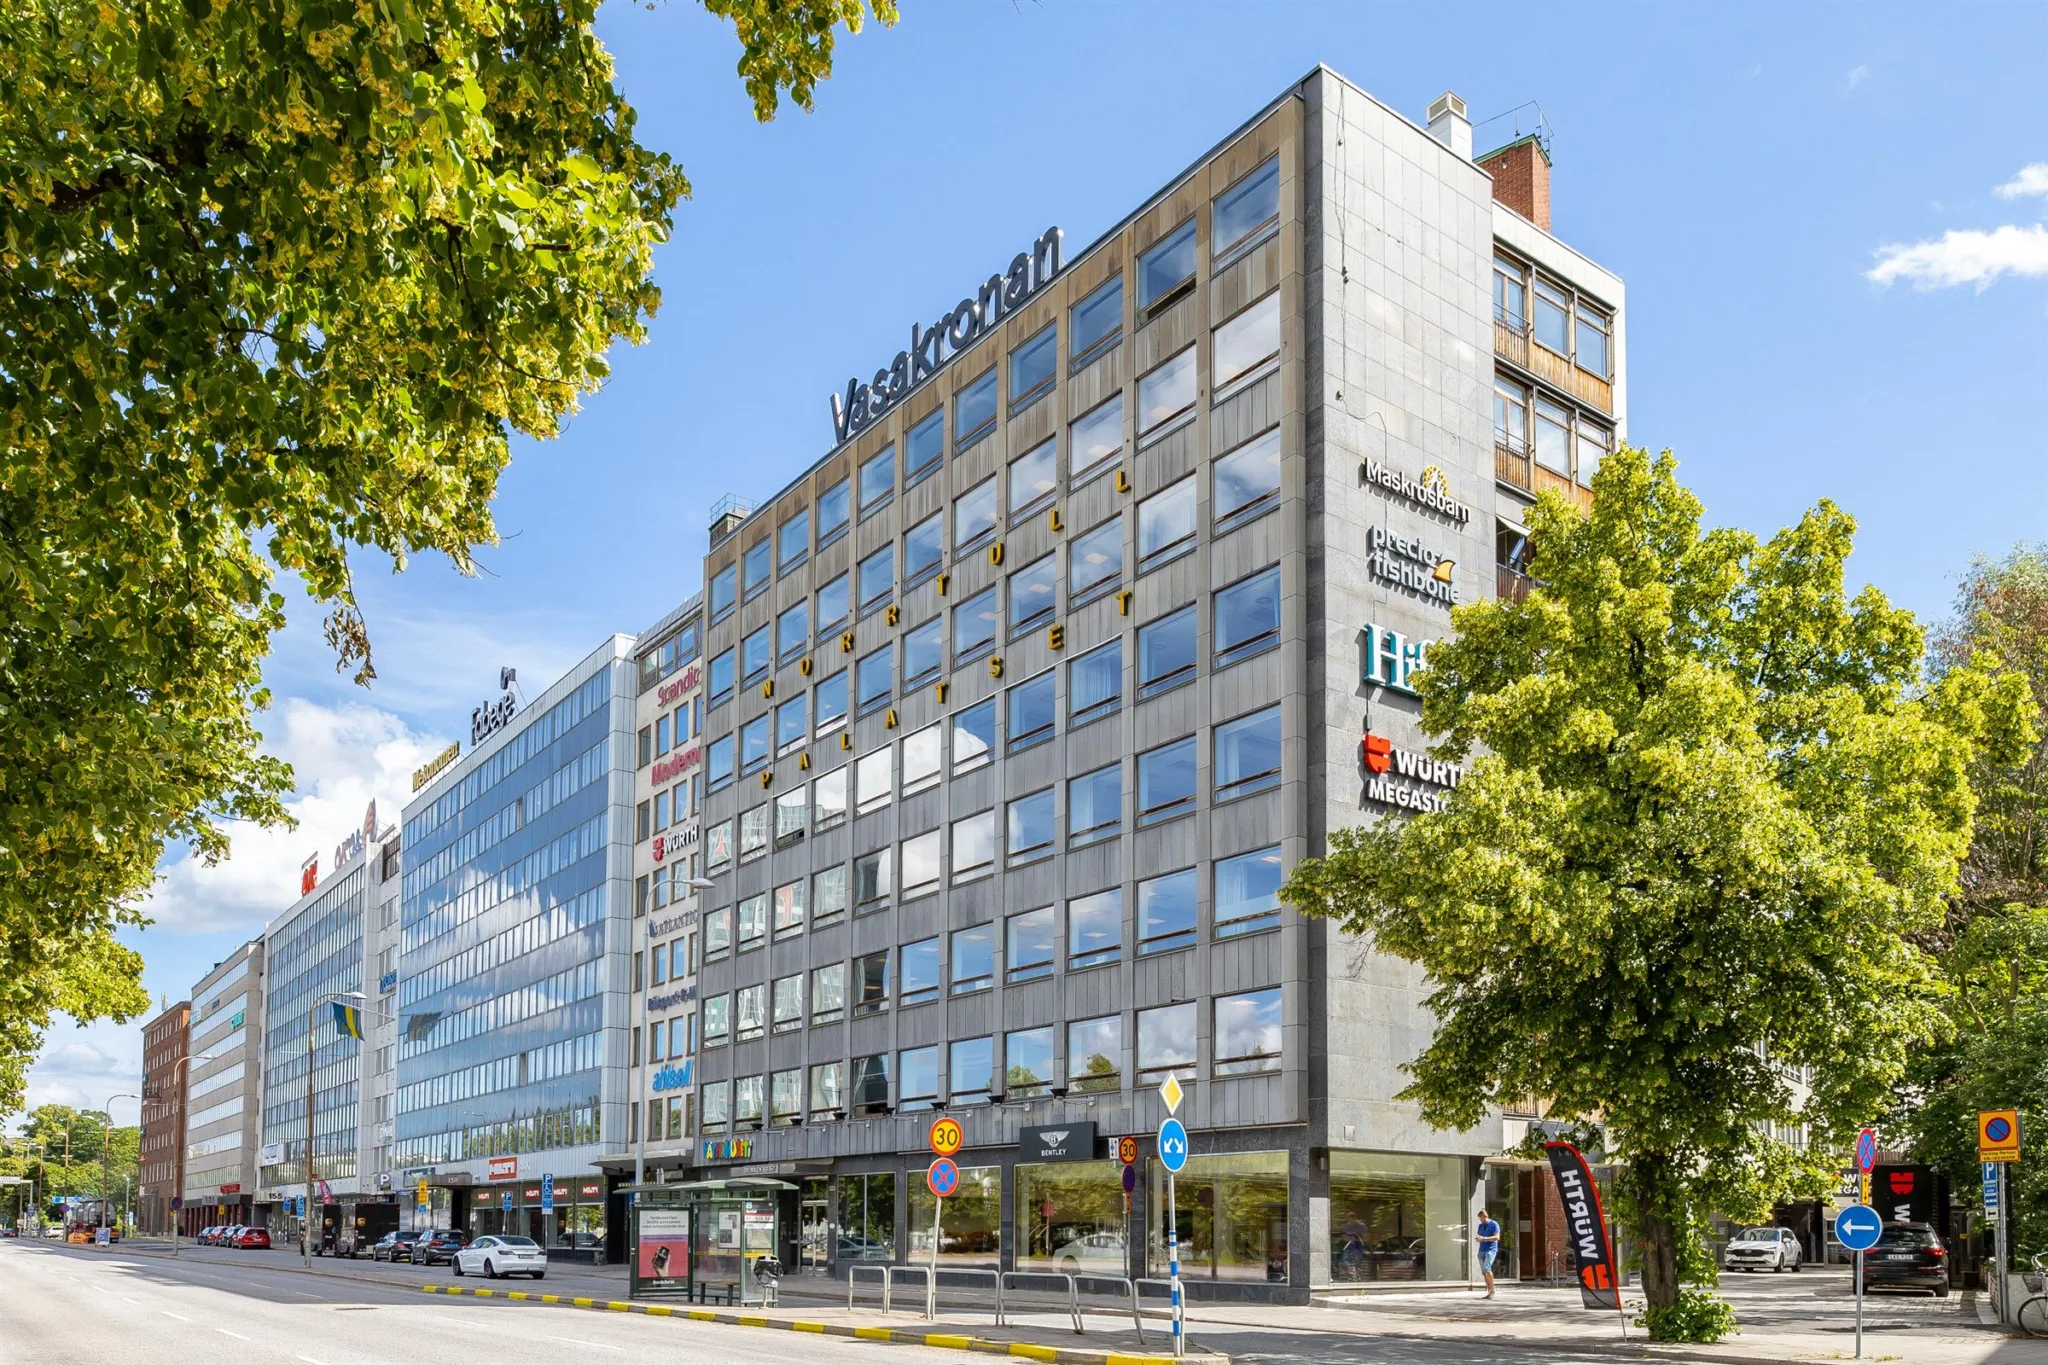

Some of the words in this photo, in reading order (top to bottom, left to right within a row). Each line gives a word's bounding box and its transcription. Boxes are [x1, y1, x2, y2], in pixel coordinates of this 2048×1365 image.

[830, 225, 1064, 444] Vasakronan
[1364, 456, 1472, 524] Maskrosbarn
[1372, 525, 1439, 566] precio
[761, 470, 1131, 699] NORRTULL
[1372, 549, 1461, 604] fishbone
[760, 590, 1132, 789] PALATSET
[471, 691, 516, 747] Fabege
[412, 740, 460, 793] Mekonomen
[651, 747, 700, 787] Modern
[662, 824, 699, 855] WÜRTH
[652, 1060, 694, 1092] ahlsell
[935, 1127, 958, 1147] 30
[1041, 1148, 1067, 1156] BENTLEY
[1122, 1143, 1135, 1157] 30
[380, 1173, 390, 1185] P
[488, 1161, 516, 1176] HILTI
[545, 1174, 552, 1183] P
[1986, 1162, 1995, 1179] P
[268, 1192, 283, 1200] 155
